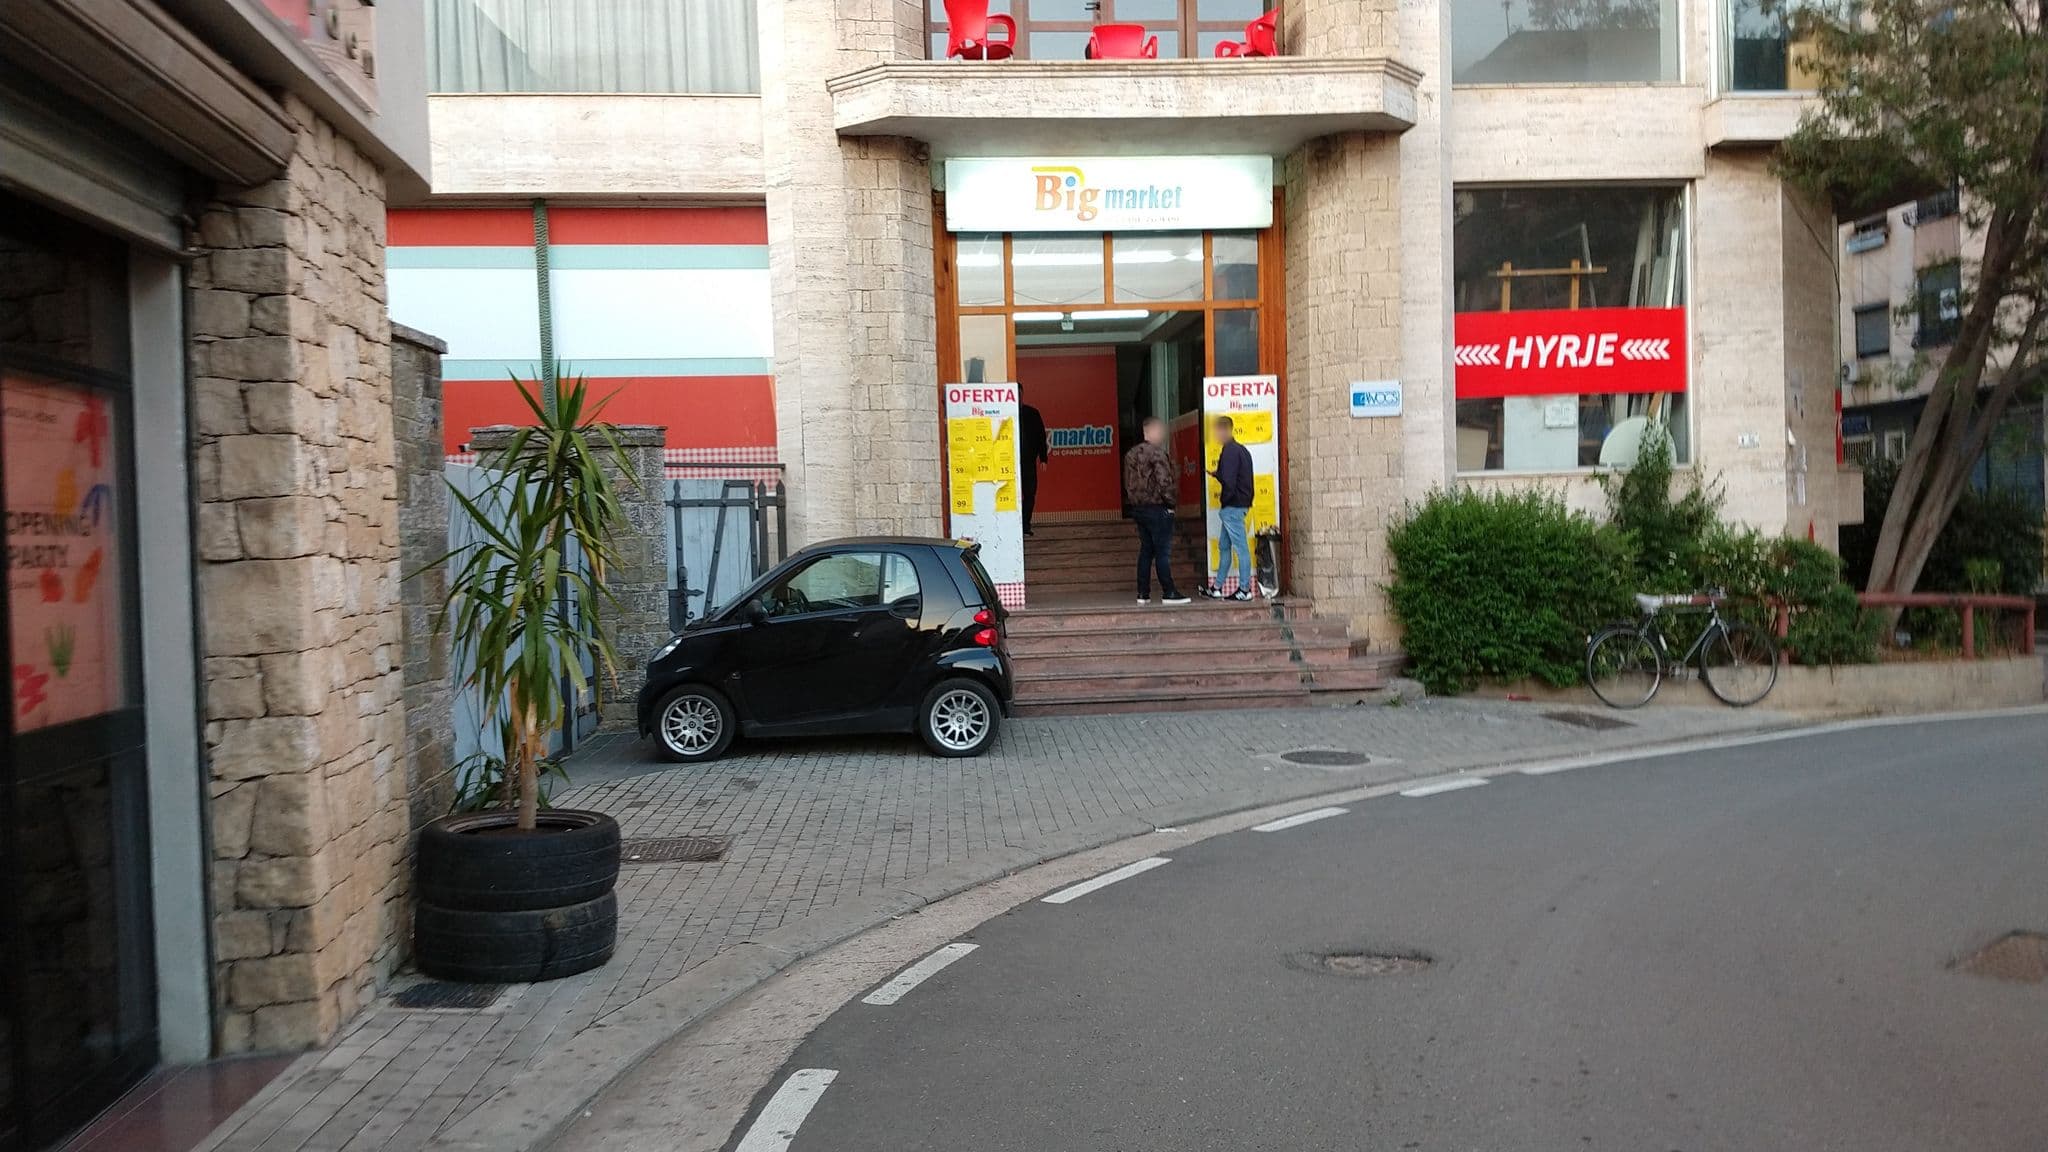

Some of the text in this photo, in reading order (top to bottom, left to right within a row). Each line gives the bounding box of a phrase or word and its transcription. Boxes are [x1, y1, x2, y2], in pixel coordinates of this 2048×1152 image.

[1035, 174, 1182, 222] Big market
[1505, 332, 1618, 369] HYRJE
[949, 389, 1015, 403] OFERTA
[1207, 382, 1275, 397] OFERTA
[1053, 426, 1112, 447] market
[6, 511, 91, 537] OPENING
[7, 544, 69, 568] PARTY
